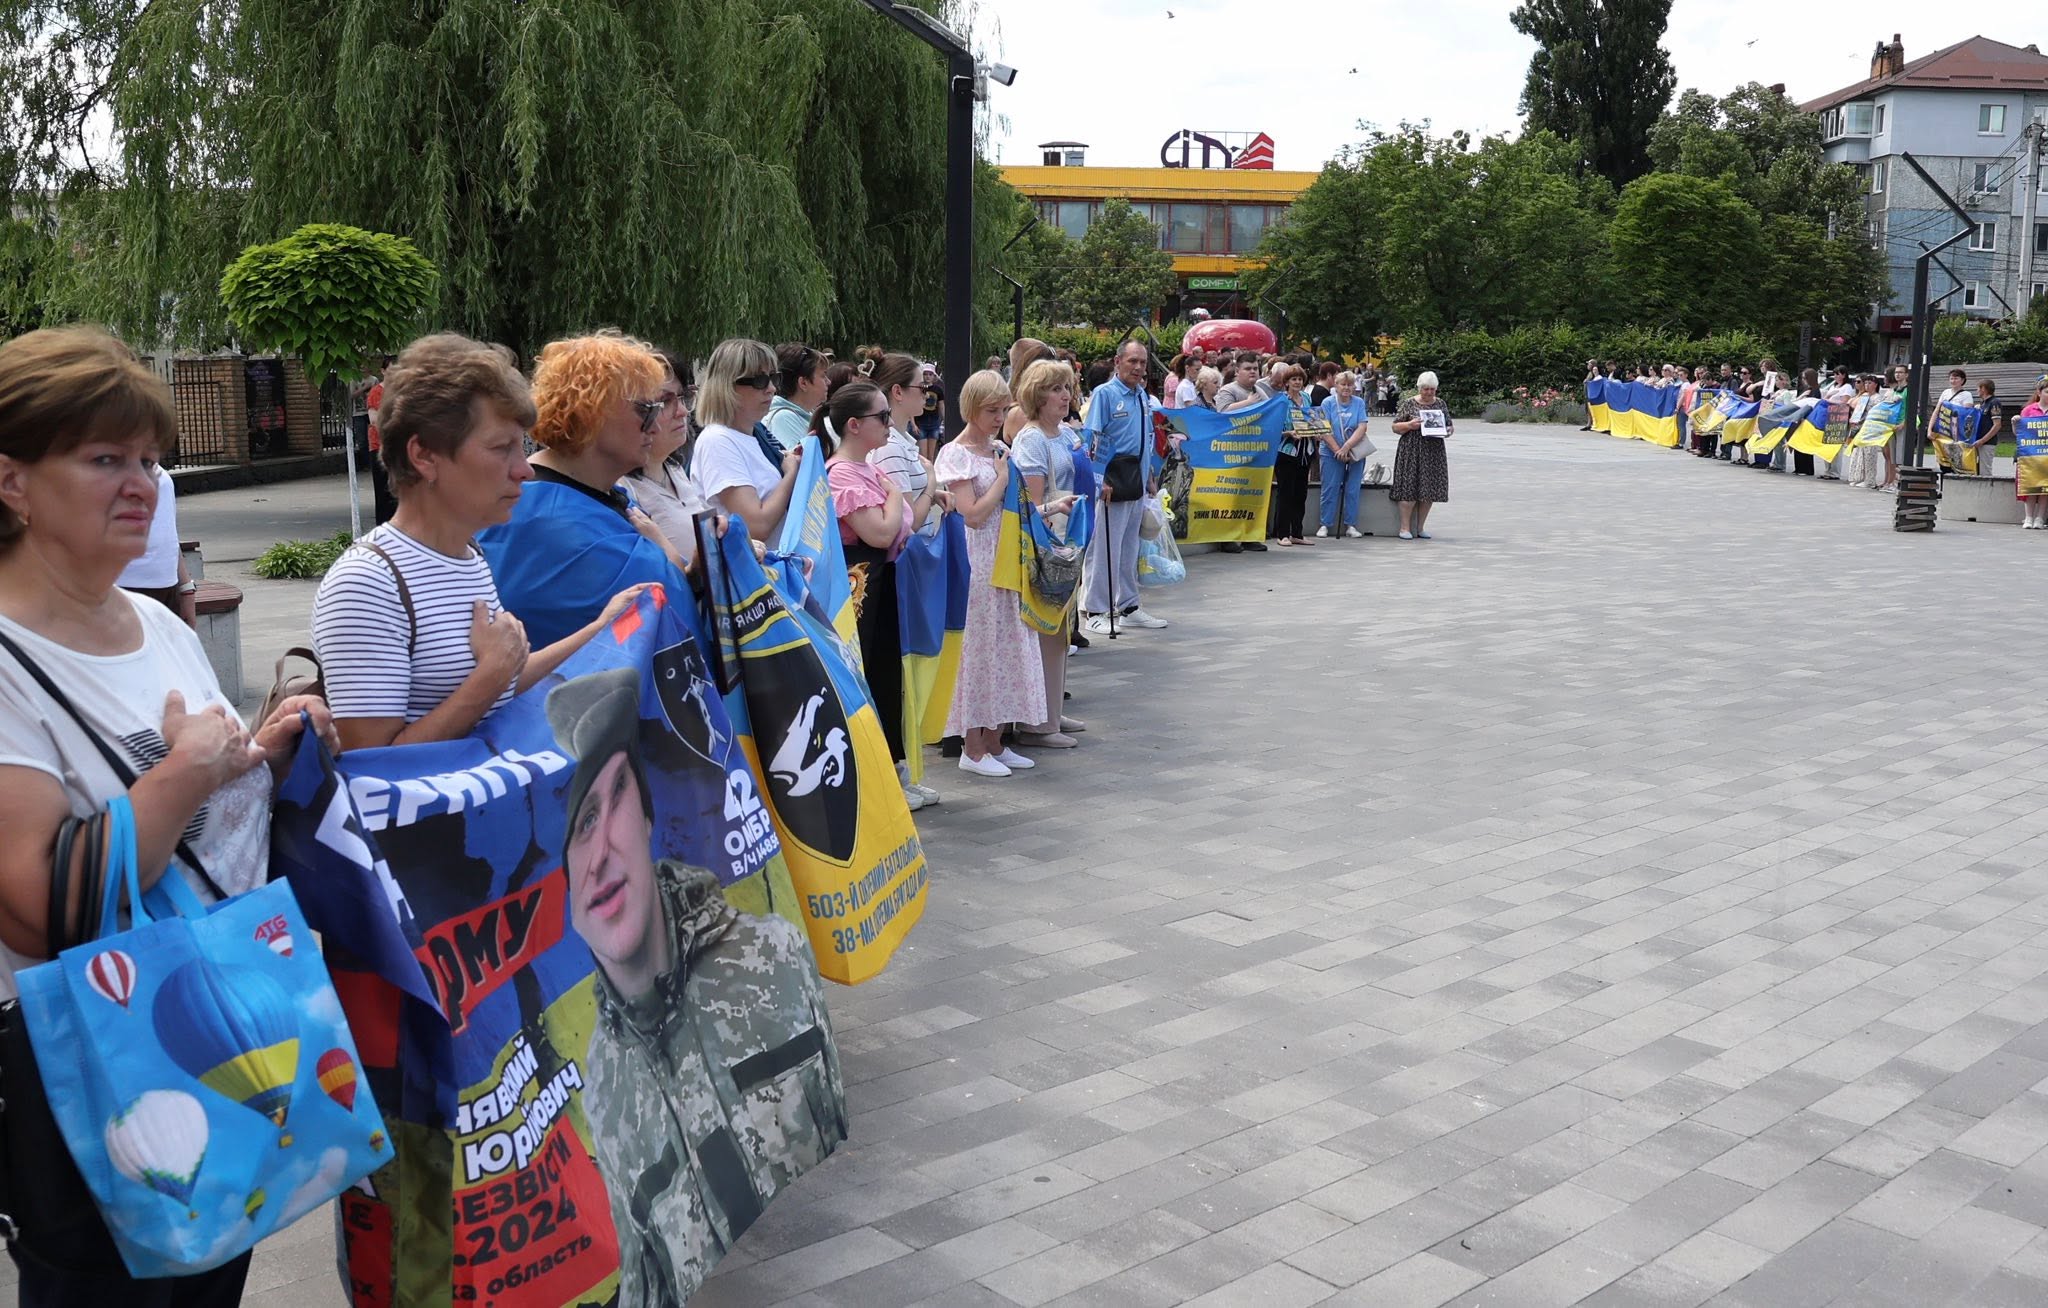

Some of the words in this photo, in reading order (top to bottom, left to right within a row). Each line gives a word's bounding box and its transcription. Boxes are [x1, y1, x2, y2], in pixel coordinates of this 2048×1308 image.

[1191, 279, 1233, 288] COMFY
[2027, 421, 2048, 430] ЛЕСН
[1210, 439, 1269, 452] Степанович
[1215, 475, 1225, 483] 22
[1211, 509, 1247, 520] 10.12.2024
[735, 601, 766, 628] ЯКЩО
[723, 768, 761, 822] 42
[724, 808, 771, 857] ОМБР
[807, 881, 860, 919] 503-Й
[254, 912, 288, 942] АТБ
[831, 915, 877, 955] 38-МА
[486, 1234, 593, 1295] область
